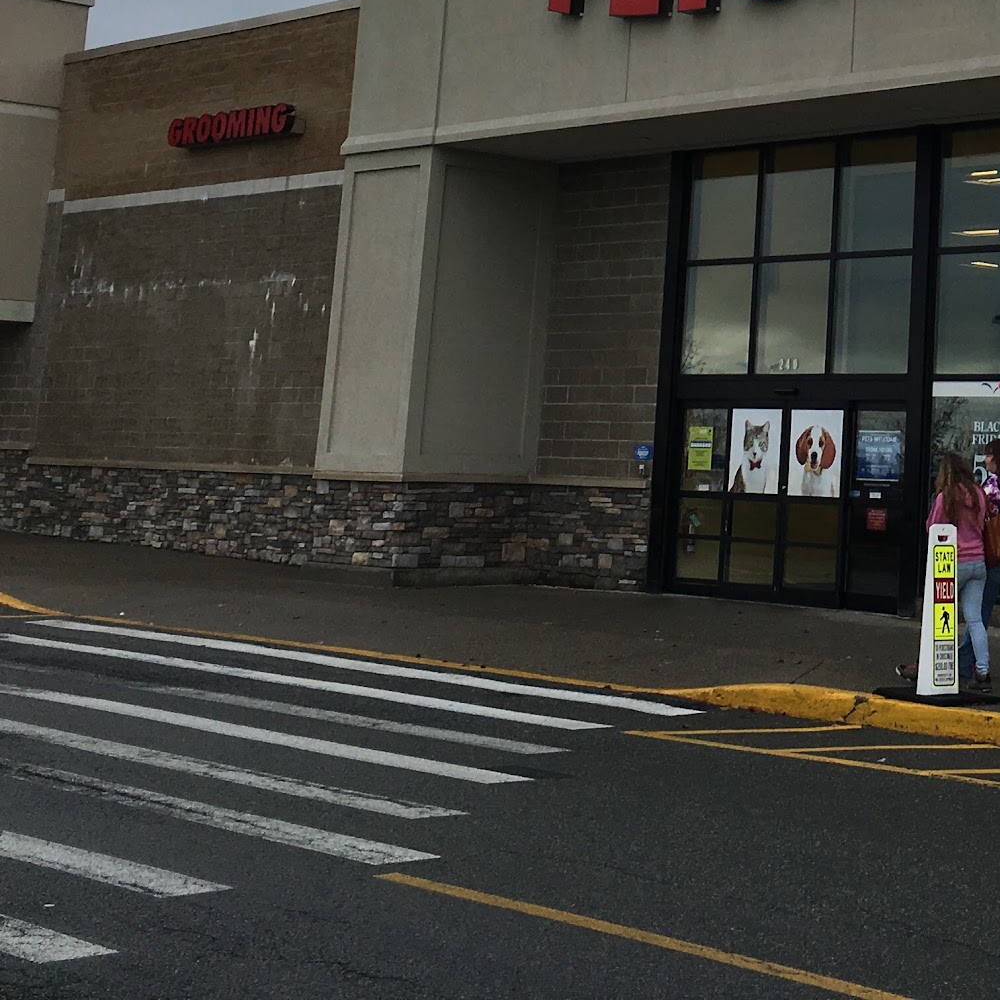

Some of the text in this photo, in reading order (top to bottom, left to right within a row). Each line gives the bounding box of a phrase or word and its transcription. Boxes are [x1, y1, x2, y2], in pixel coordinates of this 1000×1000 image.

[167, 102, 289, 148] GROOMING
[935, 551, 954, 562] STATE
[937, 563, 951, 573] LAW
[935, 581, 955, 600] YIELD
